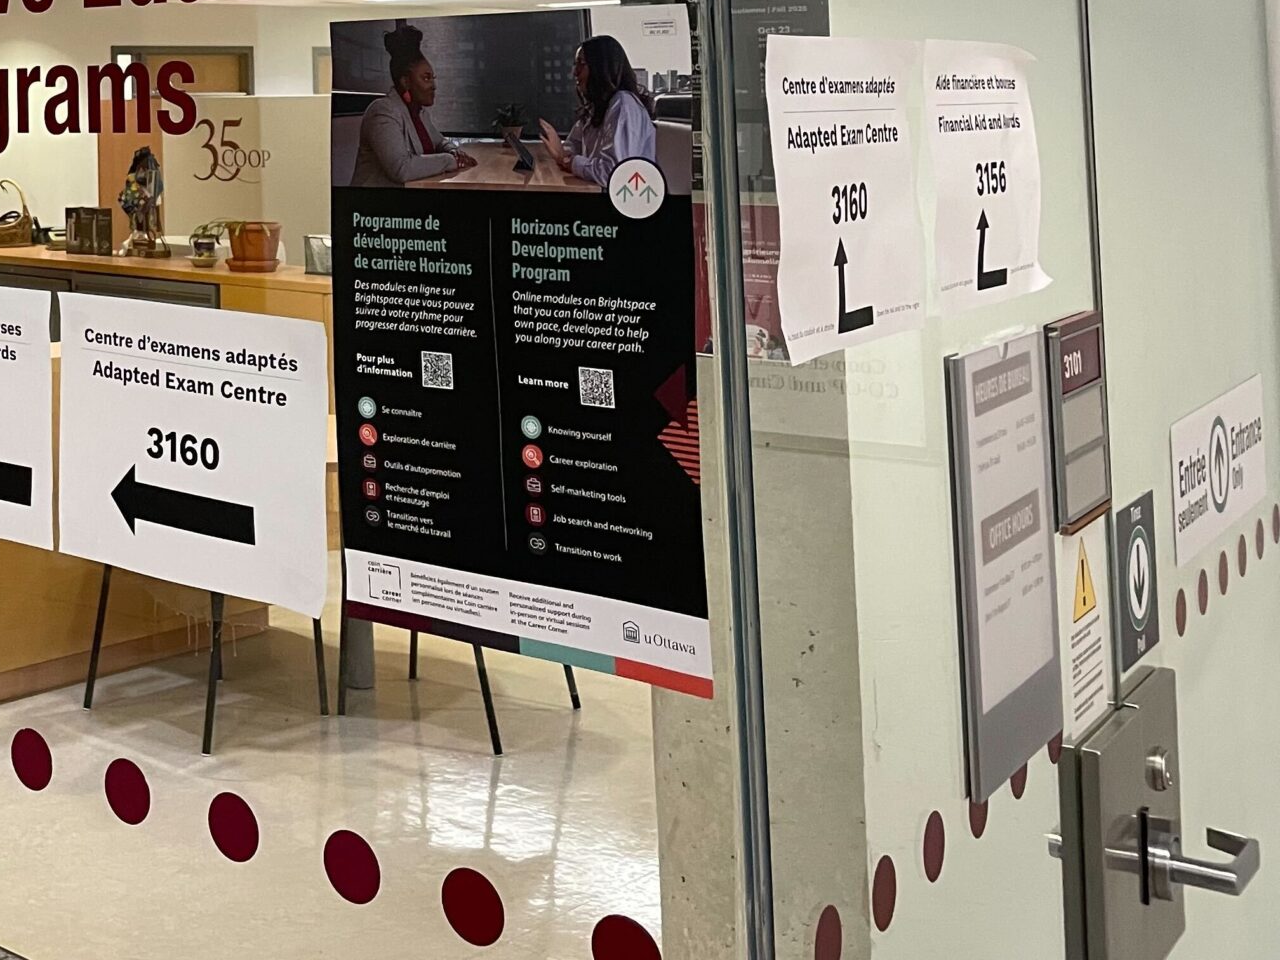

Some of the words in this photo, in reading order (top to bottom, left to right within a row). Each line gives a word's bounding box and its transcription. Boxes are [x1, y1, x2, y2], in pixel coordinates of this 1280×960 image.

[783, 77, 816, 95] Centre
[820, 76, 864, 94] d'examens
[866, 76, 895, 98] adaptés
[936, 75, 950, 90] Aide
[952, 74, 985, 90] financière
[987, 76, 995, 90] et
[938, 115, 973, 133] Financial
[975, 115, 986, 130] Aid
[989, 115, 1002, 129] and
[788, 126, 837, 154] Adapted
[841, 125, 863, 146] Exam
[866, 124, 898, 144] Centre
[194, 117, 242, 181] 35
[222, 149, 270, 167] COOP
[976, 161, 1006, 196] 3156
[832, 182, 867, 225] 3160
[353, 213, 421, 232] Programme
[425, 215, 439, 231] de
[512, 218, 569, 236] Horizons
[573, 221, 618, 238] Career
[353, 233, 447, 254] développement
[512, 241, 603, 262] Development
[355, 254, 368, 269] de
[371, 256, 416, 272] carrière
[420, 258, 472, 275] Horizons
[512, 263, 570, 284] Program
[355, 280, 369, 290] Des
[371, 282, 406, 292] modules
[420, 284, 440, 296] ligne
[443, 288, 455, 296] sur
[355, 293, 403, 307] Brightspace
[405, 297, 420, 308] que
[422, 299, 441, 308] vous
[443, 301, 474, 310] pouvez
[513, 291, 541, 302] Online
[543, 294, 582, 305] modules
[584, 298, 596, 306] on
[598, 297, 656, 311] Brightspace
[356, 307, 380, 316] suivre
[381, 308, 386, 316] à
[389, 310, 409, 319] votre
[411, 310, 441, 321] rythme
[443, 314, 463, 323] pour
[514, 305, 532, 315] that
[535, 308, 551, 318] you
[554, 309, 570, 318] can
[573, 309, 603, 321] follow
[605, 312, 615, 322] at
[617, 314, 640, 325] your
[356, 320, 397, 331] progresser
[399, 322, 419, 332] dans
[421, 325, 442, 334] votre
[444, 327, 477, 337] carrière.
[515, 320, 534, 329] own
[537, 323, 560, 332] pace,
[563, 322, 612, 337] developed
[614, 327, 624, 337] to
[627, 327, 649, 340] help
[84, 328, 133, 349] Centre
[138, 335, 220, 361] d'examens
[226, 349, 298, 372] adaptés
[515, 334, 532, 343] you
[534, 334, 561, 347] along
[563, 338, 584, 349] your
[587, 340, 615, 350] career
[618, 342, 645, 353] path.
[357, 353, 375, 363] Pour
[378, 355, 394, 365] plus
[1064, 350, 1082, 378] 3101
[357, 365, 412, 378] d'information
[93, 360, 160, 386] Adapted
[166, 372, 214, 395] Exam
[221, 381, 287, 406] Centre
[519, 375, 543, 387] Learn
[545, 379, 568, 389] more
[383, 433, 420, 444] Exploration
[431, 440, 456, 450] carrière
[548, 426, 580, 439] Knowing
[582, 432, 612, 441] yourself
[147, 427, 219, 470] 3160
[384, 460, 403, 471] Outils
[405, 464, 461, 478] d'autopromotion
[550, 455, 573, 466] Career
[575, 459, 618, 472] exploration
[1179, 448, 1206, 497] Entrée
[385, 483, 419, 495] Recherche
[420, 488, 450, 500] d'emploi
[551, 484, 605, 501] Self-marketing
[607, 494, 626, 503] tools
[394, 495, 429, 508] réseautage
[387, 510, 418, 522] Transition
[420, 516, 433, 525] vers
[553, 515, 566, 524] Job
[568, 517, 592, 528] search
[594, 521, 608, 530] and
[610, 523, 653, 540] networking
[555, 543, 592, 557] Transition
[594, 550, 602, 559] to
[603, 551, 622, 562] work
[645, 633, 696, 655] uOttawa
